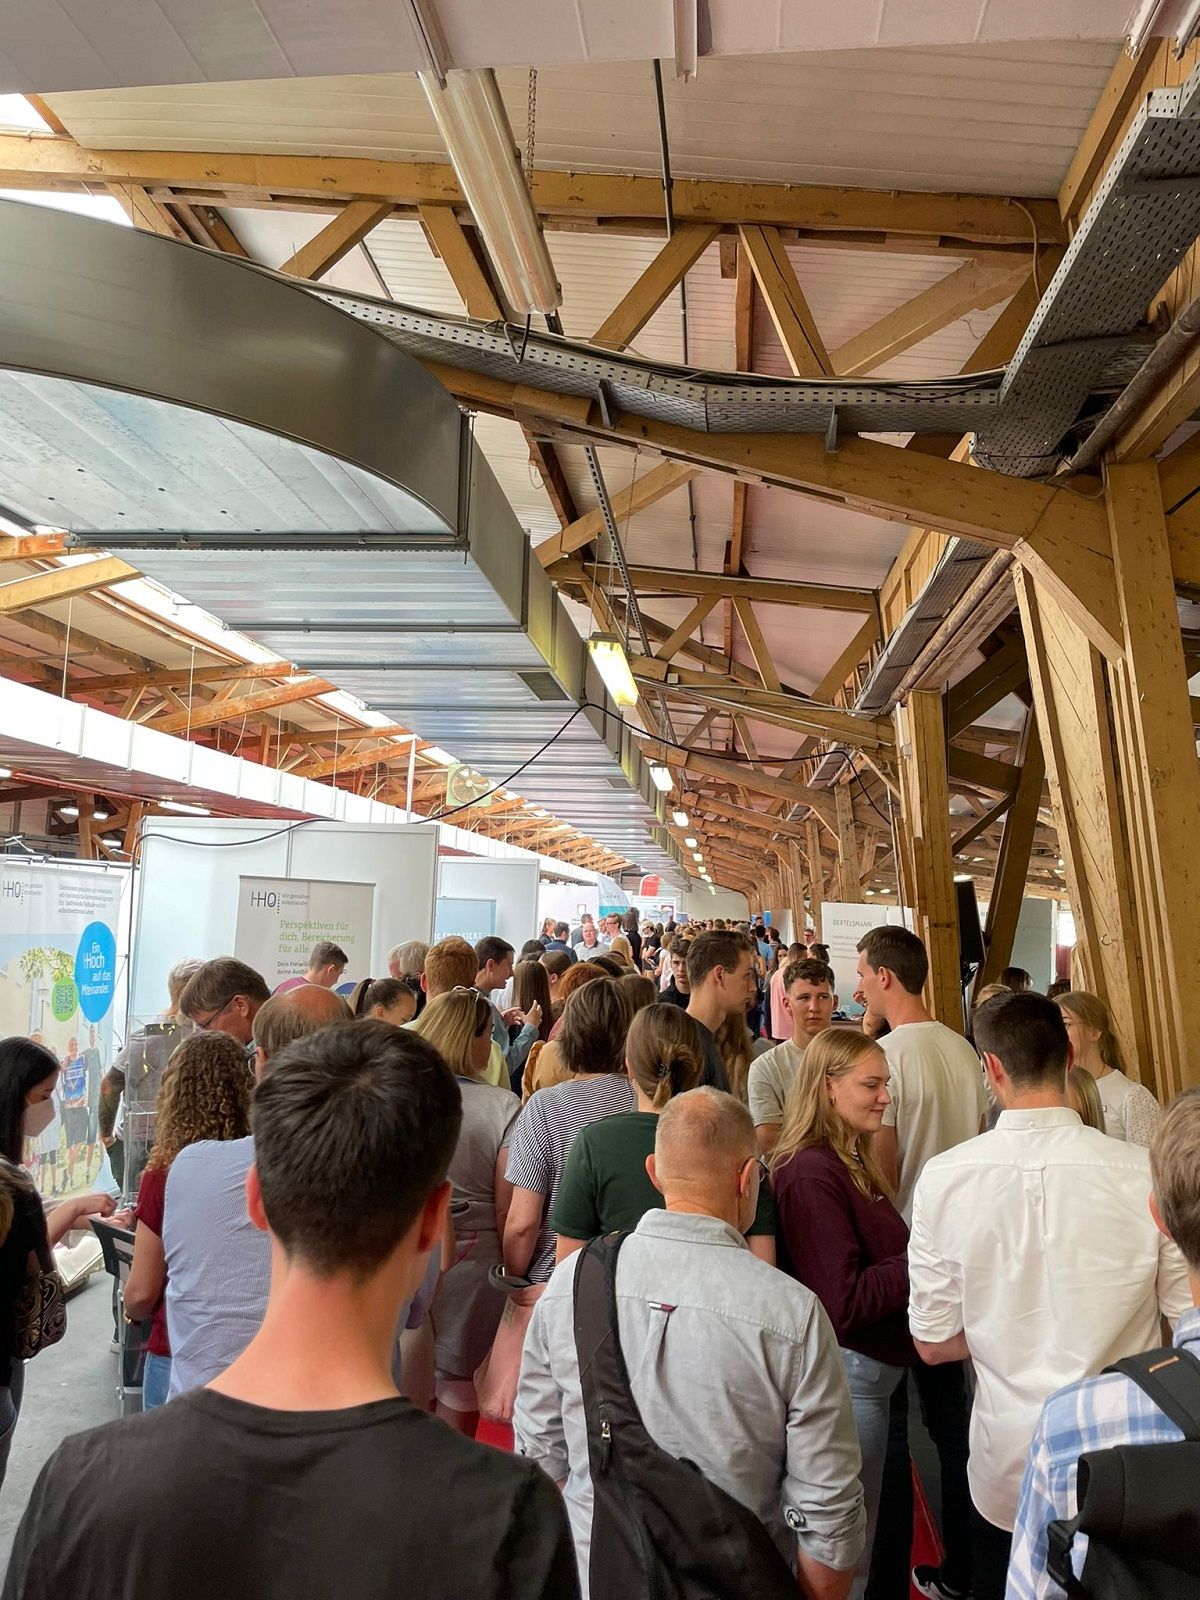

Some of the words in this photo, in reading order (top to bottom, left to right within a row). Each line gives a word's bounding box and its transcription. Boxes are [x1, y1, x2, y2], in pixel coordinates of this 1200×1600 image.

[280, 920, 333, 931] Perspektiven
[336, 922, 349, 931] für
[302, 932, 356, 944] Bereicherung
[279, 943, 291, 953] für
